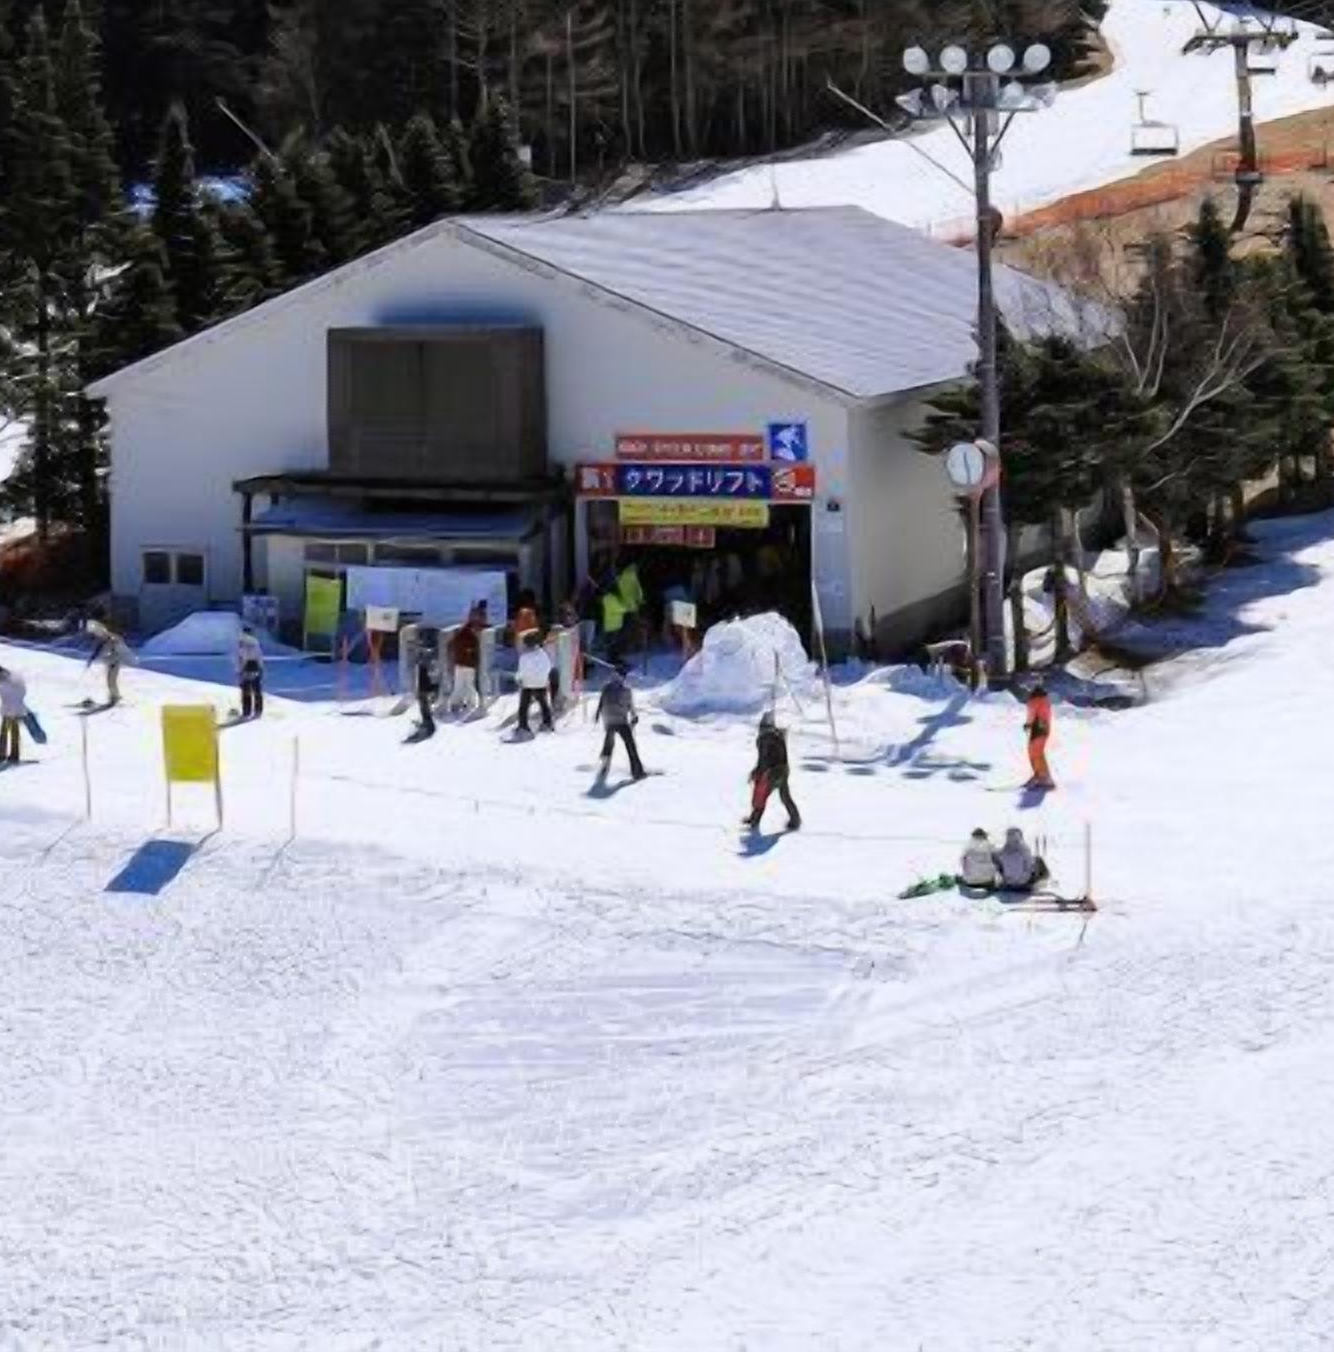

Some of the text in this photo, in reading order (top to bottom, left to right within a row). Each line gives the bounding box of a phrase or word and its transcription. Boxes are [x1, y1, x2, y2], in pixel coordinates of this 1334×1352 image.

[625, 468, 763, 493] クワッドリフト
